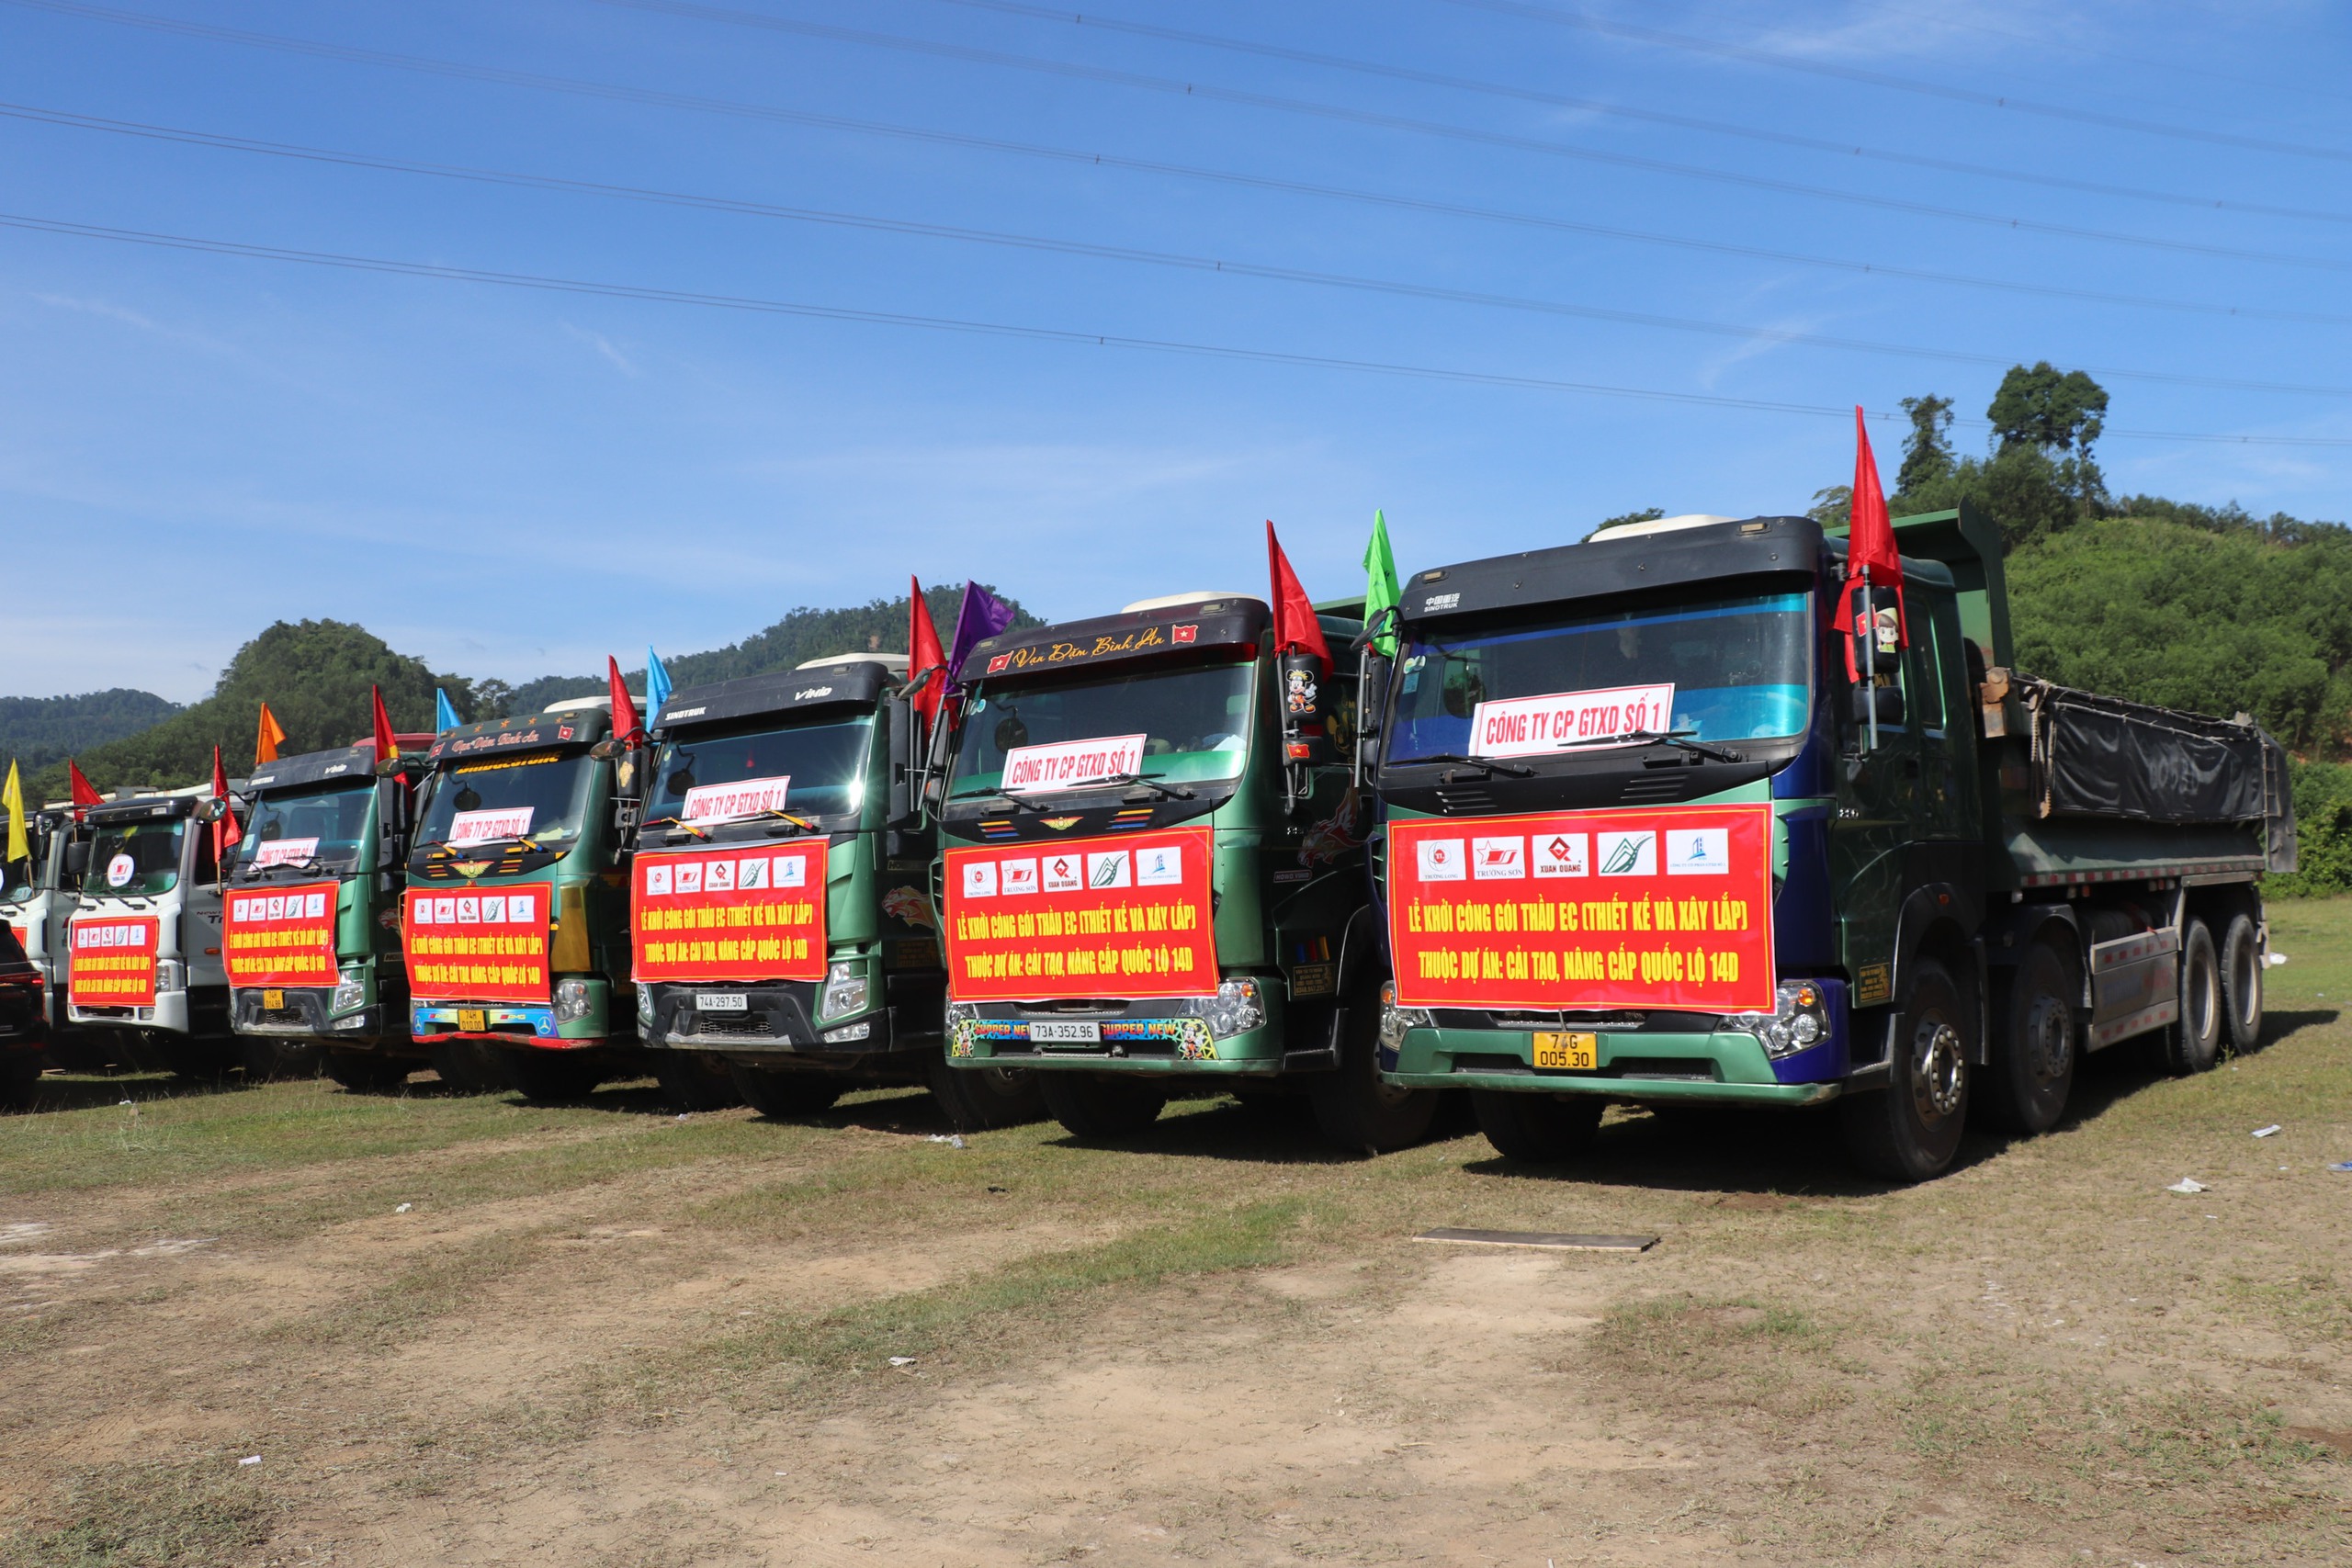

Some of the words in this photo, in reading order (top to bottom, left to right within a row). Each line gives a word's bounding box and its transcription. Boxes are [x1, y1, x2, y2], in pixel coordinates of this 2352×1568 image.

[1424, 603, 1458, 613] SINOTRUK
[1012, 647, 1046, 668] Vạn
[1091, 634, 1135, 658] Bình
[1130, 626, 1165, 652] An
[665, 706, 707, 721] SINOTRUK
[1486, 711, 1527, 745] CÔNG
[1532, 712, 1551, 740] TY
[1553, 709, 1575, 739] CP
[1578, 705, 1620, 737] GTXD
[1623, 693, 1650, 732] SỐ
[1652, 703, 1660, 730] 1
[1012, 756, 1042, 784] CÔNG
[1045, 757, 1059, 781] TY
[1059, 755, 1075, 779] CP
[1076, 752, 1106, 777] GTXD
[1108, 741, 1129, 774] SỐ
[1128, 750, 1136, 773] 1
[690, 795, 713, 818] CÔNG
[713, 796, 725, 816] TY
[724, 794, 737, 815] CP
[737, 791, 761, 813] GTXD
[775, 789, 781, 809] 1
[1476, 868, 1506, 877] TRƯỜNG
[1508, 868, 1523, 876] SƠN
[1540, 865, 1556, 874] XUAN
[1559, 863, 1581, 873] QUANG
[717, 907, 726, 928] EC
[753, 899, 764, 926] KẾ
[957, 910, 967, 941] LỄ
[967, 910, 989, 940] KHỞI
[990, 911, 1016, 939] CÔNG
[1017, 909, 1035, 937] GÓI
[1036, 905, 1062, 936] THẦU
[1064, 910, 1077, 935] EC
[1080, 901, 1112, 934] (THIẾT
[1114, 900, 1128, 932] KẾ
[1129, 904, 1146, 931] VÀ
[1147, 902, 1168, 931] XÂY
[1170, 897, 1196, 930] LẮP)
[1408, 897, 1422, 932] LỄ
[1423, 898, 1453, 932] KHỞI
[1456, 899, 1492, 932] CÔNG
[1495, 899, 1518, 931] GÓI
[1521, 894, 1555, 931] THẦU
[1559, 902, 1577, 931] EC
[1582, 892, 1628, 931] (THIẾT
[1632, 892, 1651, 931] KẾ
[1654, 896, 1676, 931] VÀ
[1679, 896, 1708, 931] XÂY
[1713, 892, 1747, 931] LẮP)
[741, 933, 756, 961] CẤP
[793, 939, 808, 960] 14D
[965, 951, 992, 982] THUỘC
[994, 951, 1007, 981] DỰ
[1008, 950, 1023, 976] ÁN:
[1025, 947, 1041, 976] CẢI
[1044, 952, 1065, 980] TẠO,
[1068, 947, 1096, 975] NÂNG
[1098, 942, 1118, 974] CẤP
[1121, 941, 1152, 976] QUỐC
[1155, 943, 1170, 977] LỘ
[1171, 947, 1193, 972] 14D
[1419, 946, 1458, 984] THUỘC
[1461, 947, 1480, 984] DỰ
[1482, 947, 1503, 979] ÁN:
[1506, 944, 1529, 979] CẢI
[1532, 951, 1560, 986] TẠO,
[1564, 946, 1604, 980] NÂNG
[1608, 942, 1637, 980] CẤP
[1641, 942, 1683, 984] QUỐC
[1687, 946, 1705, 987] LỘ
[1710, 952, 1739, 982] 14D
[700, 997, 742, 1008] 74A-297.50
[465, 1010, 477, 1020] 74H
[975, 1024, 1011, 1035] SUPPER
[1035, 1025, 1093, 1038] 73A-352.96
[1148, 1023, 1176, 1034] NEW
[1540, 1051, 1589, 1066] 005.30
